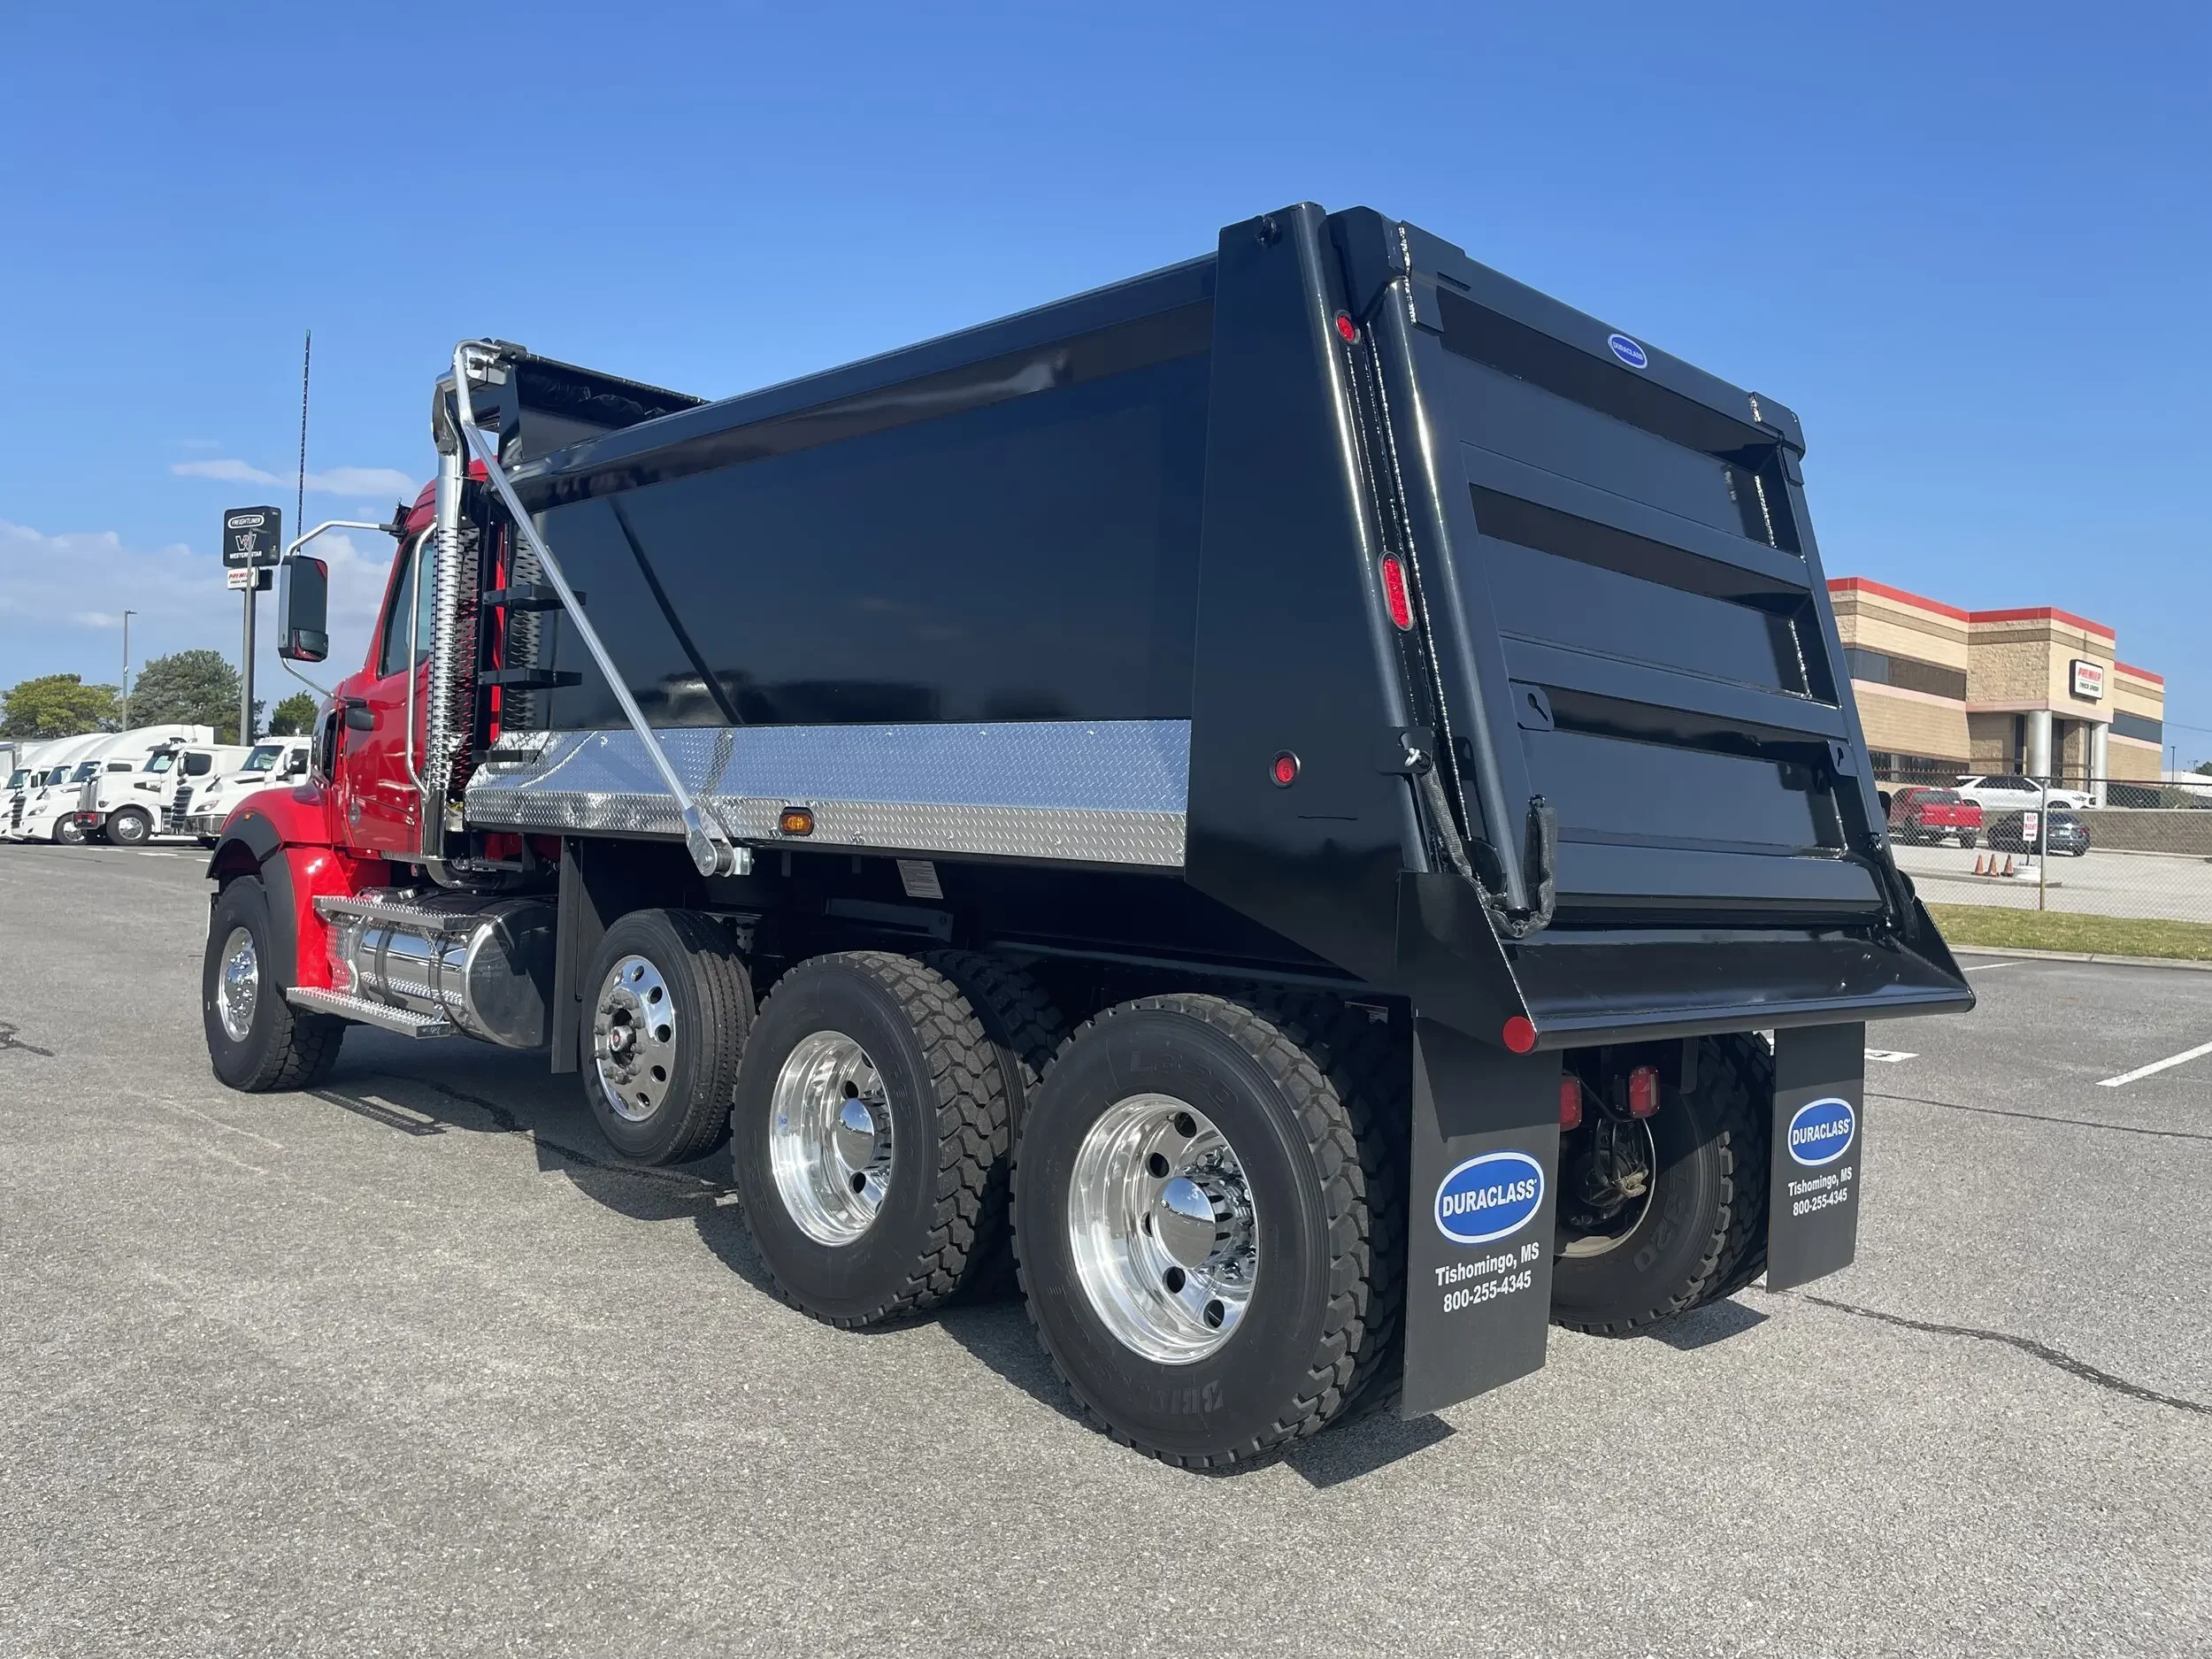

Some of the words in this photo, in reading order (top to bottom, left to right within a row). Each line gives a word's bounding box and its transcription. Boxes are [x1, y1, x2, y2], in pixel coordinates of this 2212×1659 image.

[231, 517, 261, 526] FREIGHTLINER
[2078, 667, 2101, 681] PREMIER
[1793, 1118, 1850, 1146] DURACLASS
[1787, 1174, 1839, 1196] Tishomingo,
[1840, 1166, 1853, 1183] MS
[1442, 1178, 1536, 1217] DURACLASS
[1793, 1187, 1847, 1217] 800-255-4345
[1435, 1254, 1517, 1286] Tishomingo,
[1521, 1241, 1540, 1263] MS
[1443, 1270, 1532, 1313] 800-255-4345
